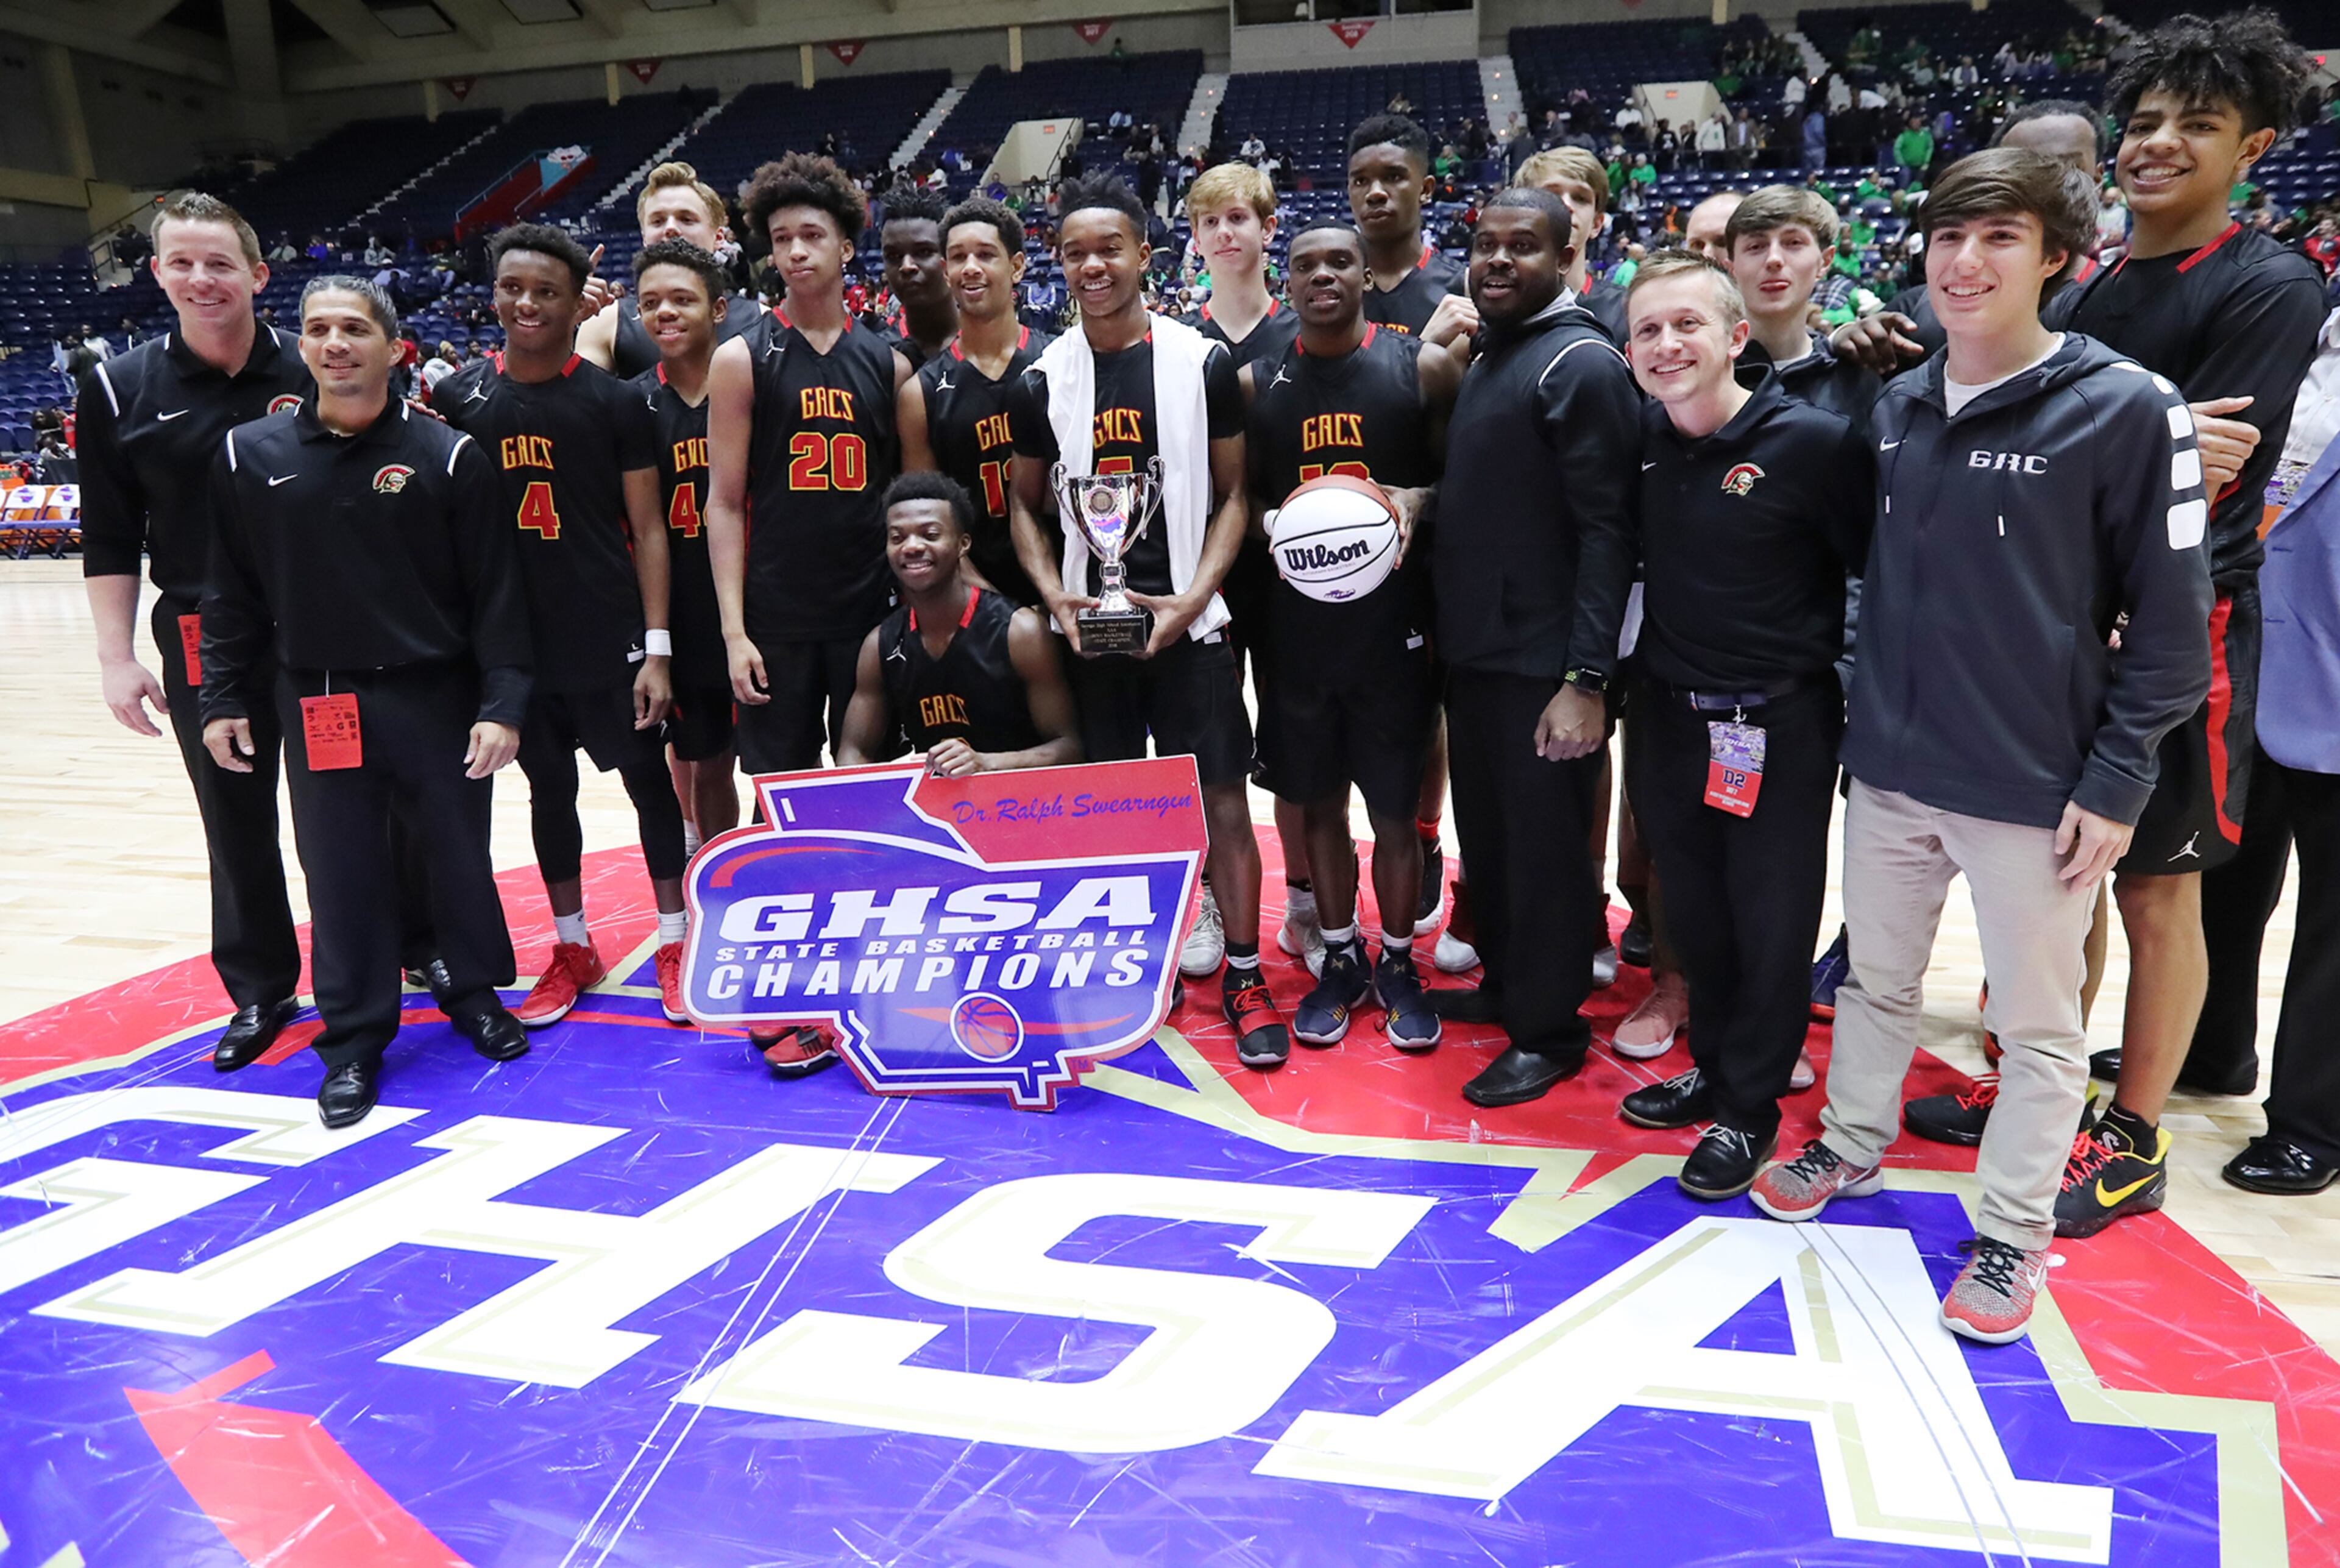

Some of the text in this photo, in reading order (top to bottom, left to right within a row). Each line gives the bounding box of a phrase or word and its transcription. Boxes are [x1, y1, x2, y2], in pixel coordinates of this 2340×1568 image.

[800, 386, 855, 421] GACS
[975, 411, 1014, 451] GAC
[1093, 408, 1143, 450] GACS
[1302, 413, 1364, 452] GACS
[500, 434, 555, 470] GACS
[672, 437, 709, 474] GAC
[789, 431, 867, 491] 20
[517, 481, 561, 540] 4
[668, 481, 708, 538] 4
[1284, 539, 1370, 572] Wilson
[920, 694, 971, 727] GACS
[1723, 768, 1746, 789] D2
[952, 793, 1193, 825] Dr. Ralph Swearngin
[718, 875, 1157, 943] GHSA
[715, 929, 1146, 962] STATE BASKETBALL
[706, 948, 1149, 1000] CHAMPIONS
